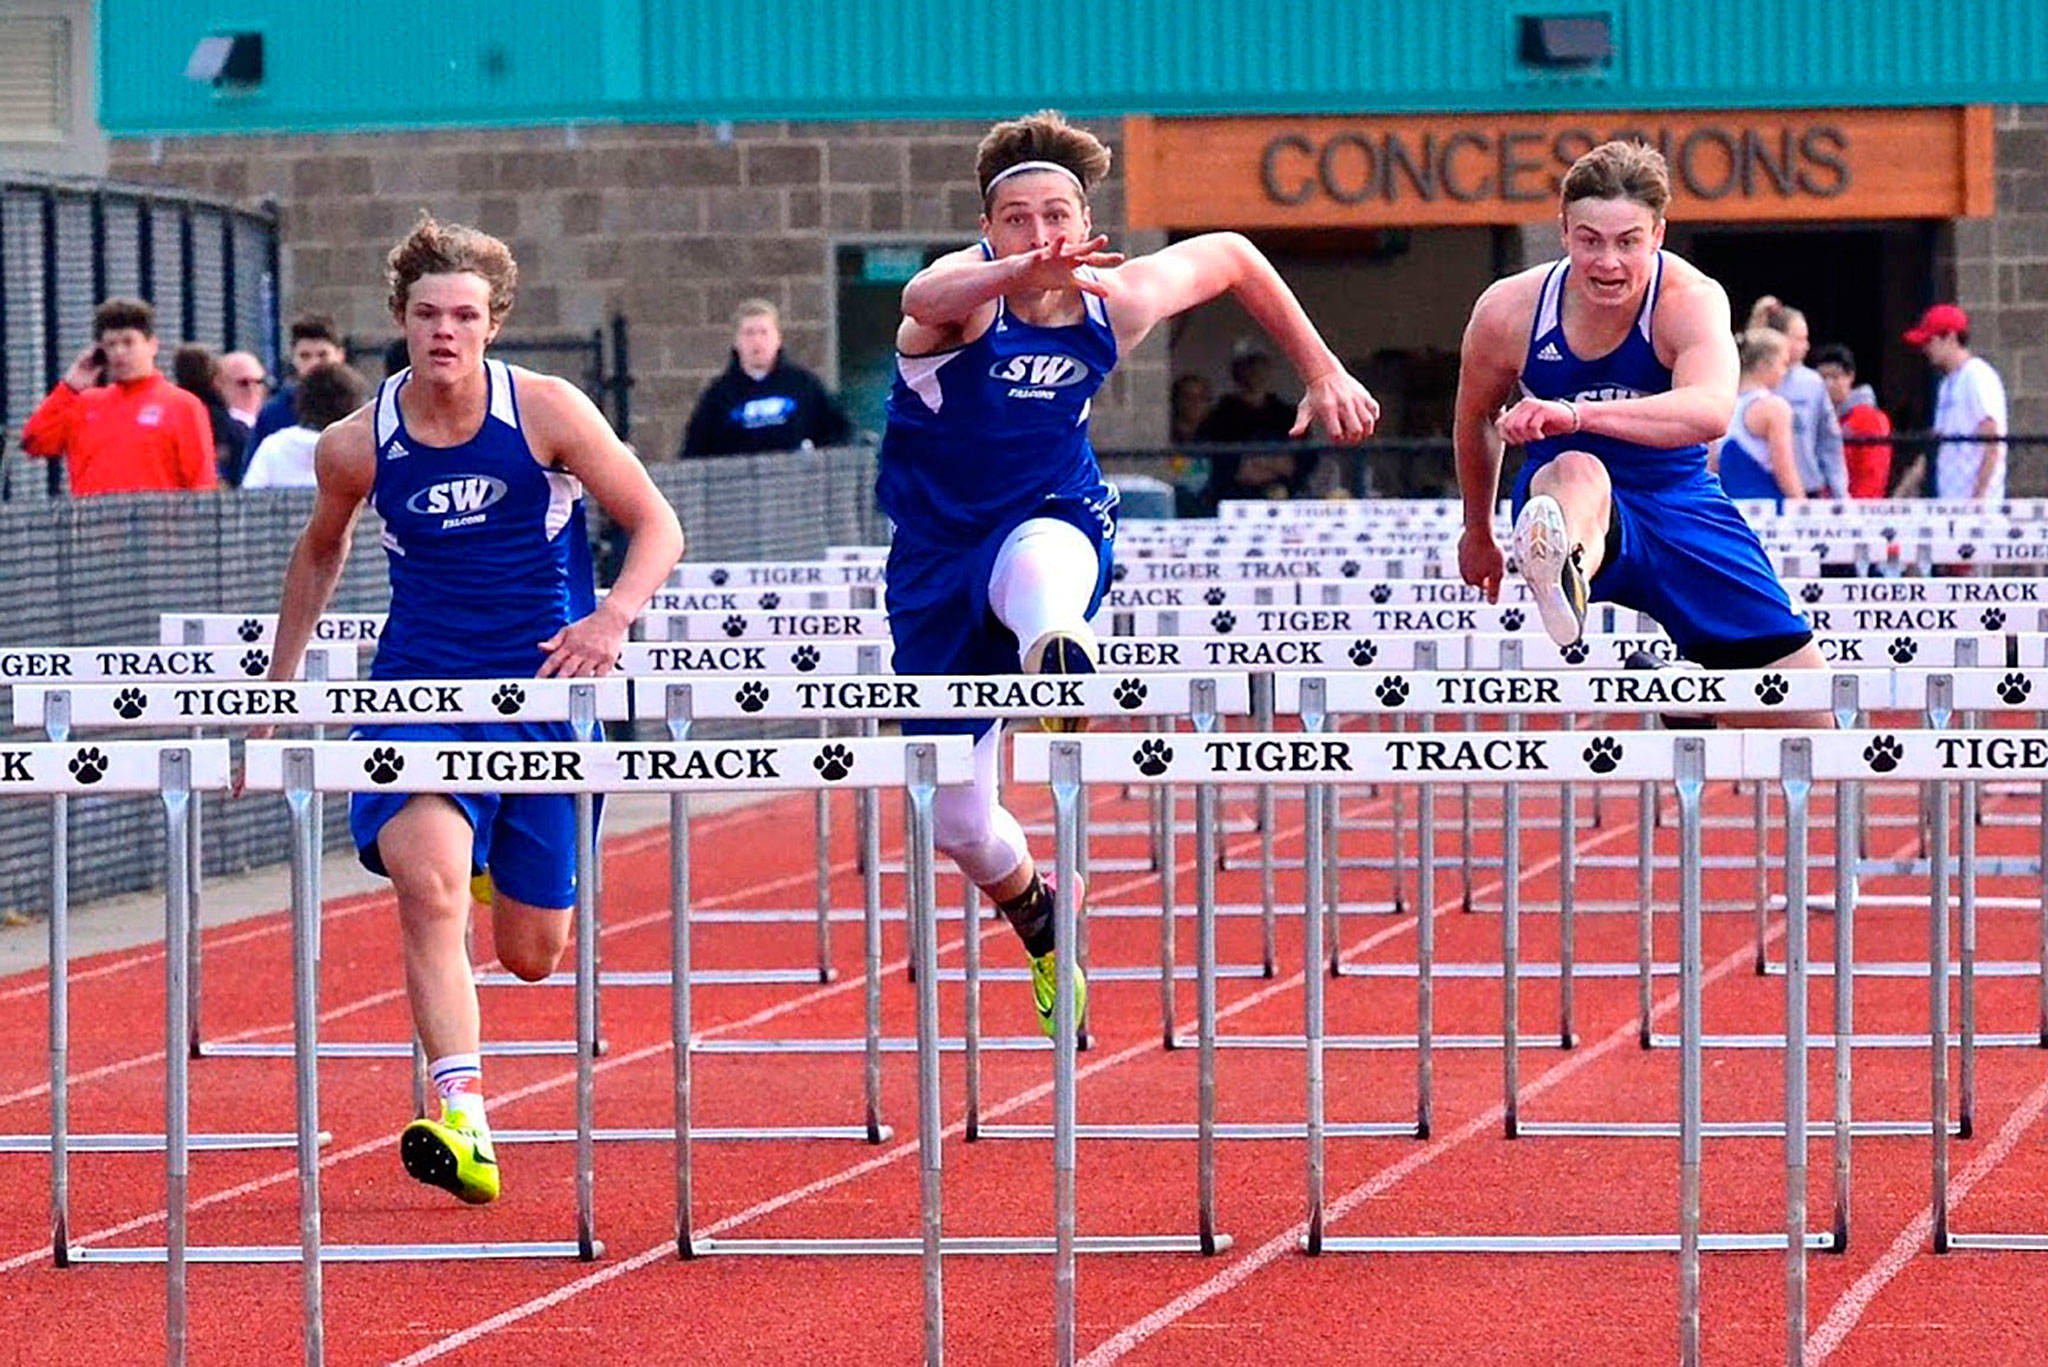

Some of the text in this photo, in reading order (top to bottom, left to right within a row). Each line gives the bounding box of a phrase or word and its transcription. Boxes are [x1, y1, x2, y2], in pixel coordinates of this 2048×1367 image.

[1261, 125, 1851, 205] CONCESIONS
[1002, 355, 1073, 383] SW
[1008, 388, 1055, 399] FALCONS
[428, 479, 490, 514] SW
[442, 514, 486, 529] FALCONS
[1992, 544, 2048, 559] TIGE
[747, 566, 885, 585] TIGER TRA
[1145, 561, 1322, 581] TIGER TRACK
[1110, 588, 1183, 607] RACK
[1842, 584, 2038, 602] TIGER TRACK
[316, 620, 377, 640] GER
[768, 616, 862, 635] TIGER
[1258, 610, 1476, 631] TIGER TRACK
[1854, 610, 1957, 629] TRACK
[1, 652, 215, 677] GER TRACK
[648, 648, 766, 670] TRACK
[1097, 642, 1323, 666] IGER TRACK
[175, 687, 463, 715] TIGER TRACK
[796, 681, 1084, 708] TIGER TRACK
[1437, 677, 1726, 703] TIGER TRACK
[1205, 740, 1548, 771] TIGER TRACK
[1936, 738, 2048, 769] TIGE
[437, 749, 779, 781] TIGER TRACK
